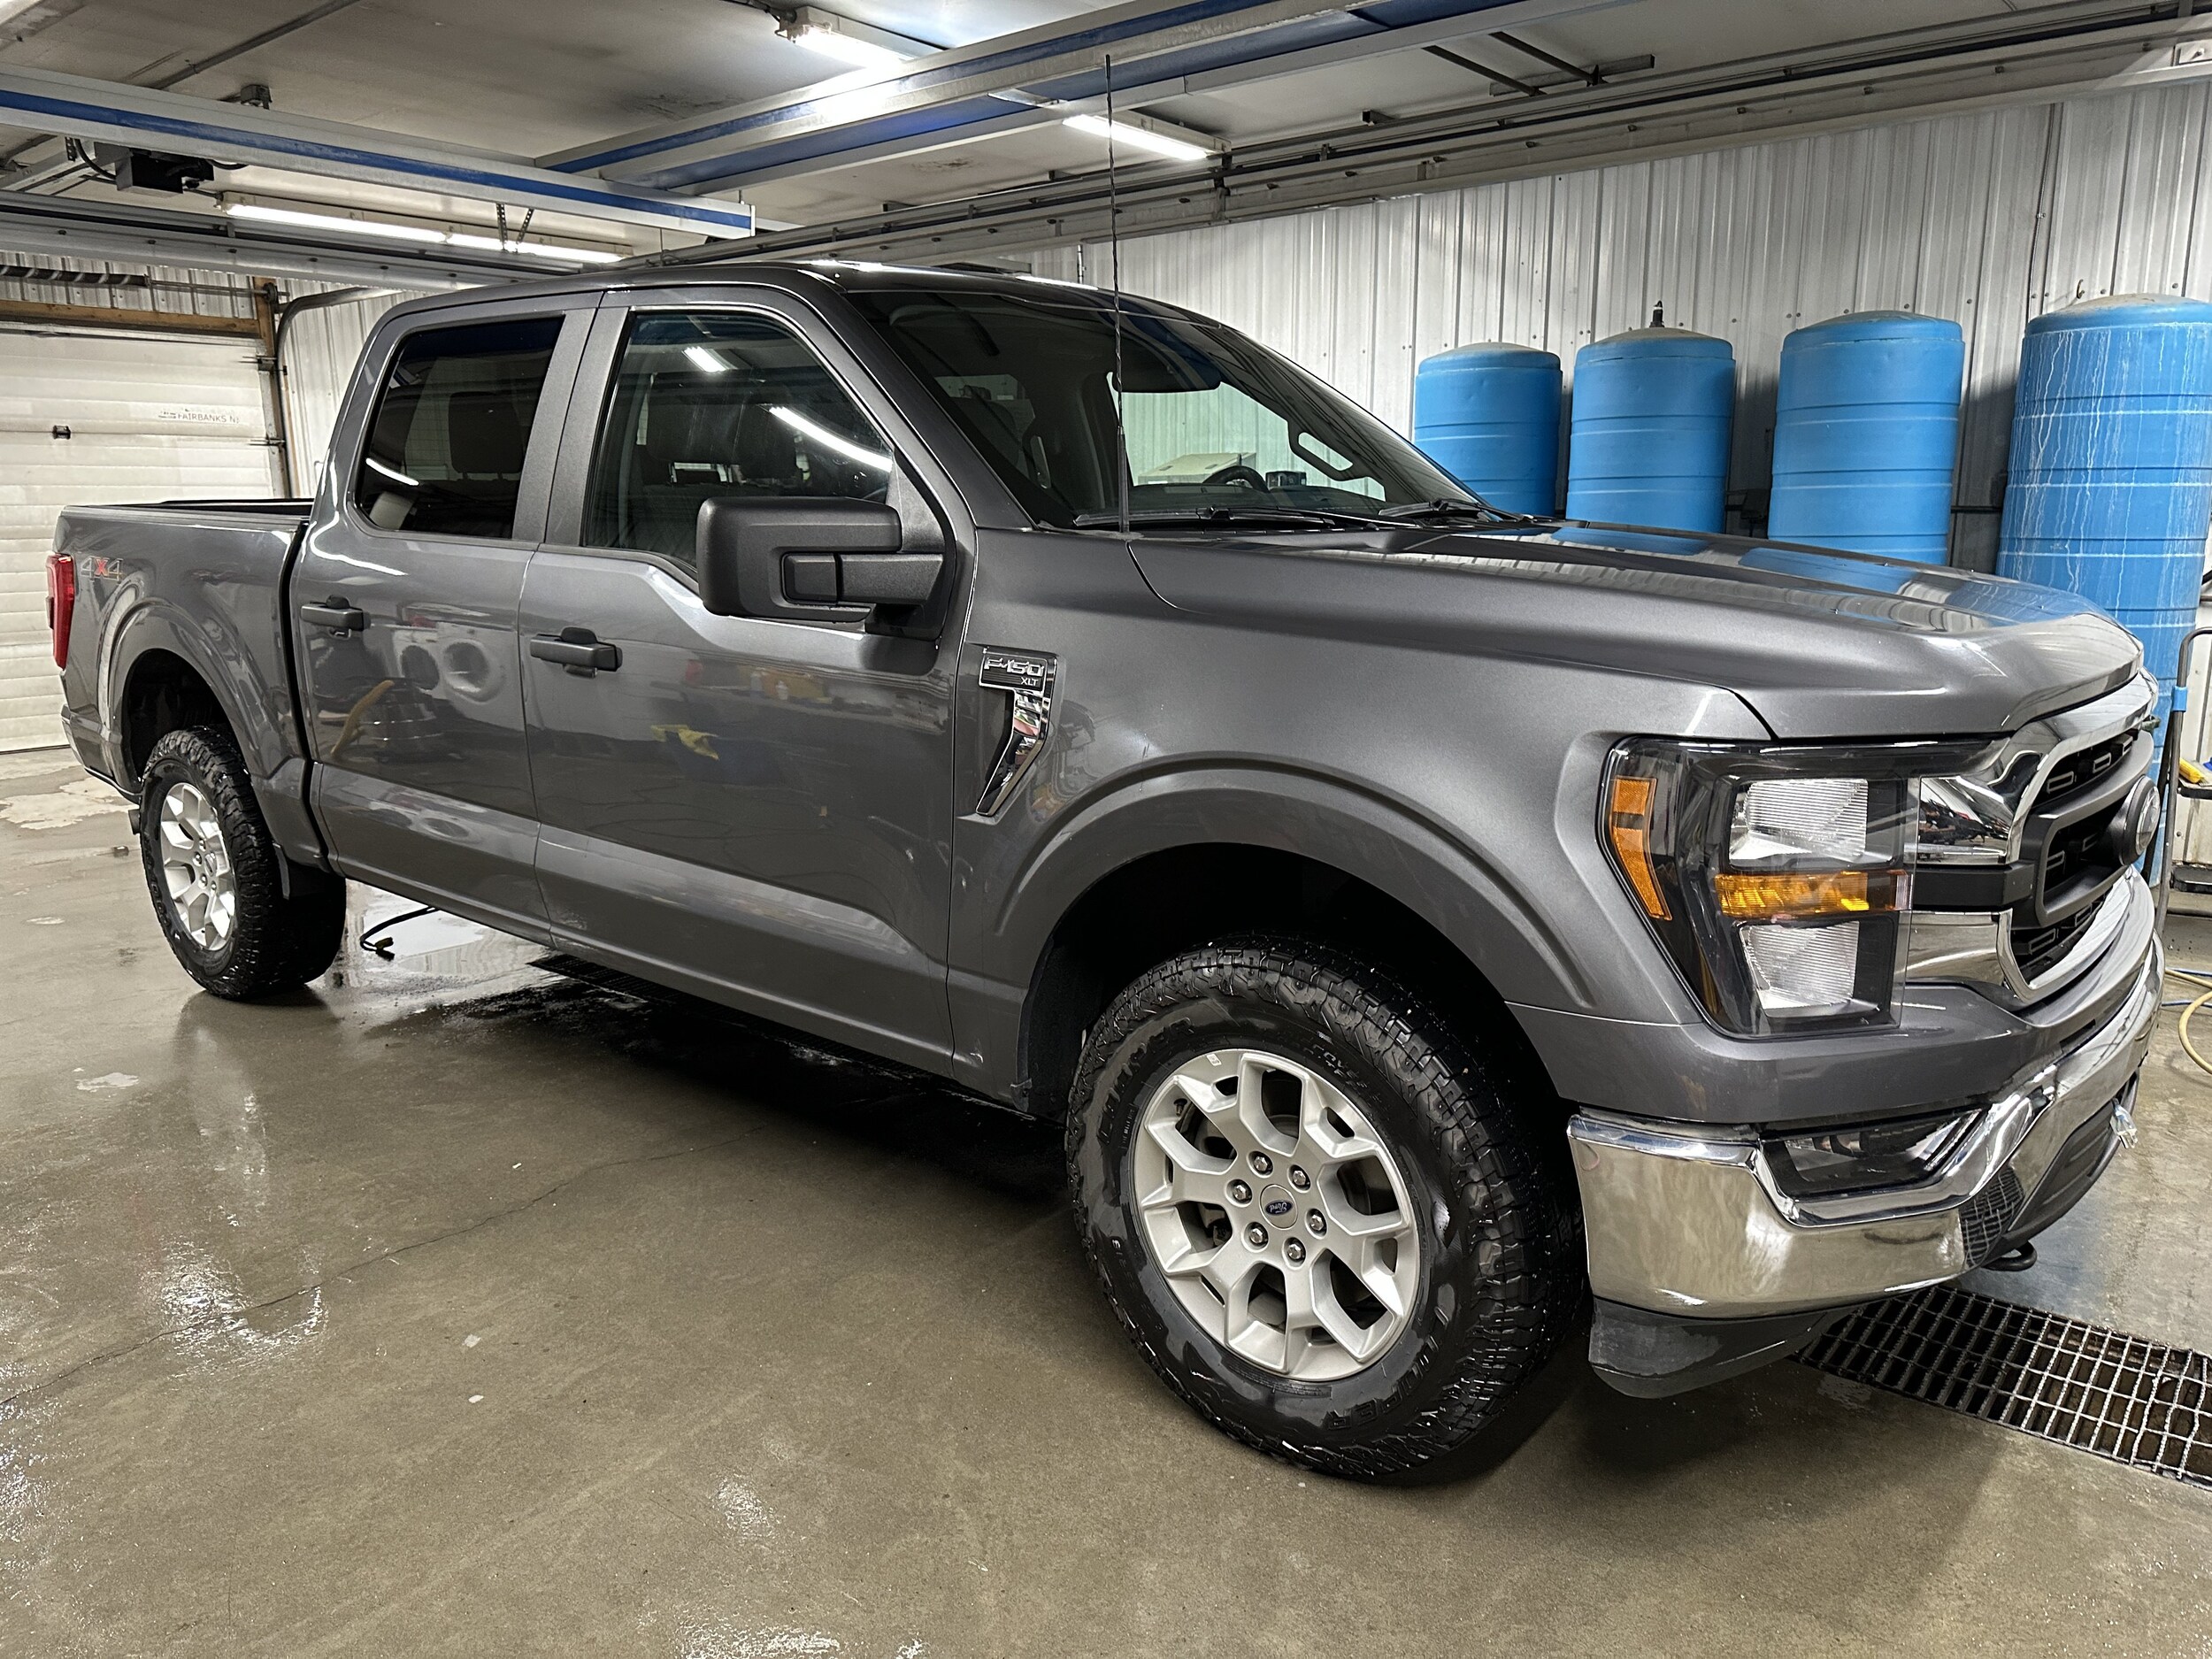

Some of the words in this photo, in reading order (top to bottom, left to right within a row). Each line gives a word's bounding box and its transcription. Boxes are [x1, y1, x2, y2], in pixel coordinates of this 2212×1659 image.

[178, 413, 227, 422] FAIRBANKS
[983, 657, 1045, 677] F-150
[1020, 677, 1040, 686] XLT
[1267, 1202, 1289, 1214] Ford
